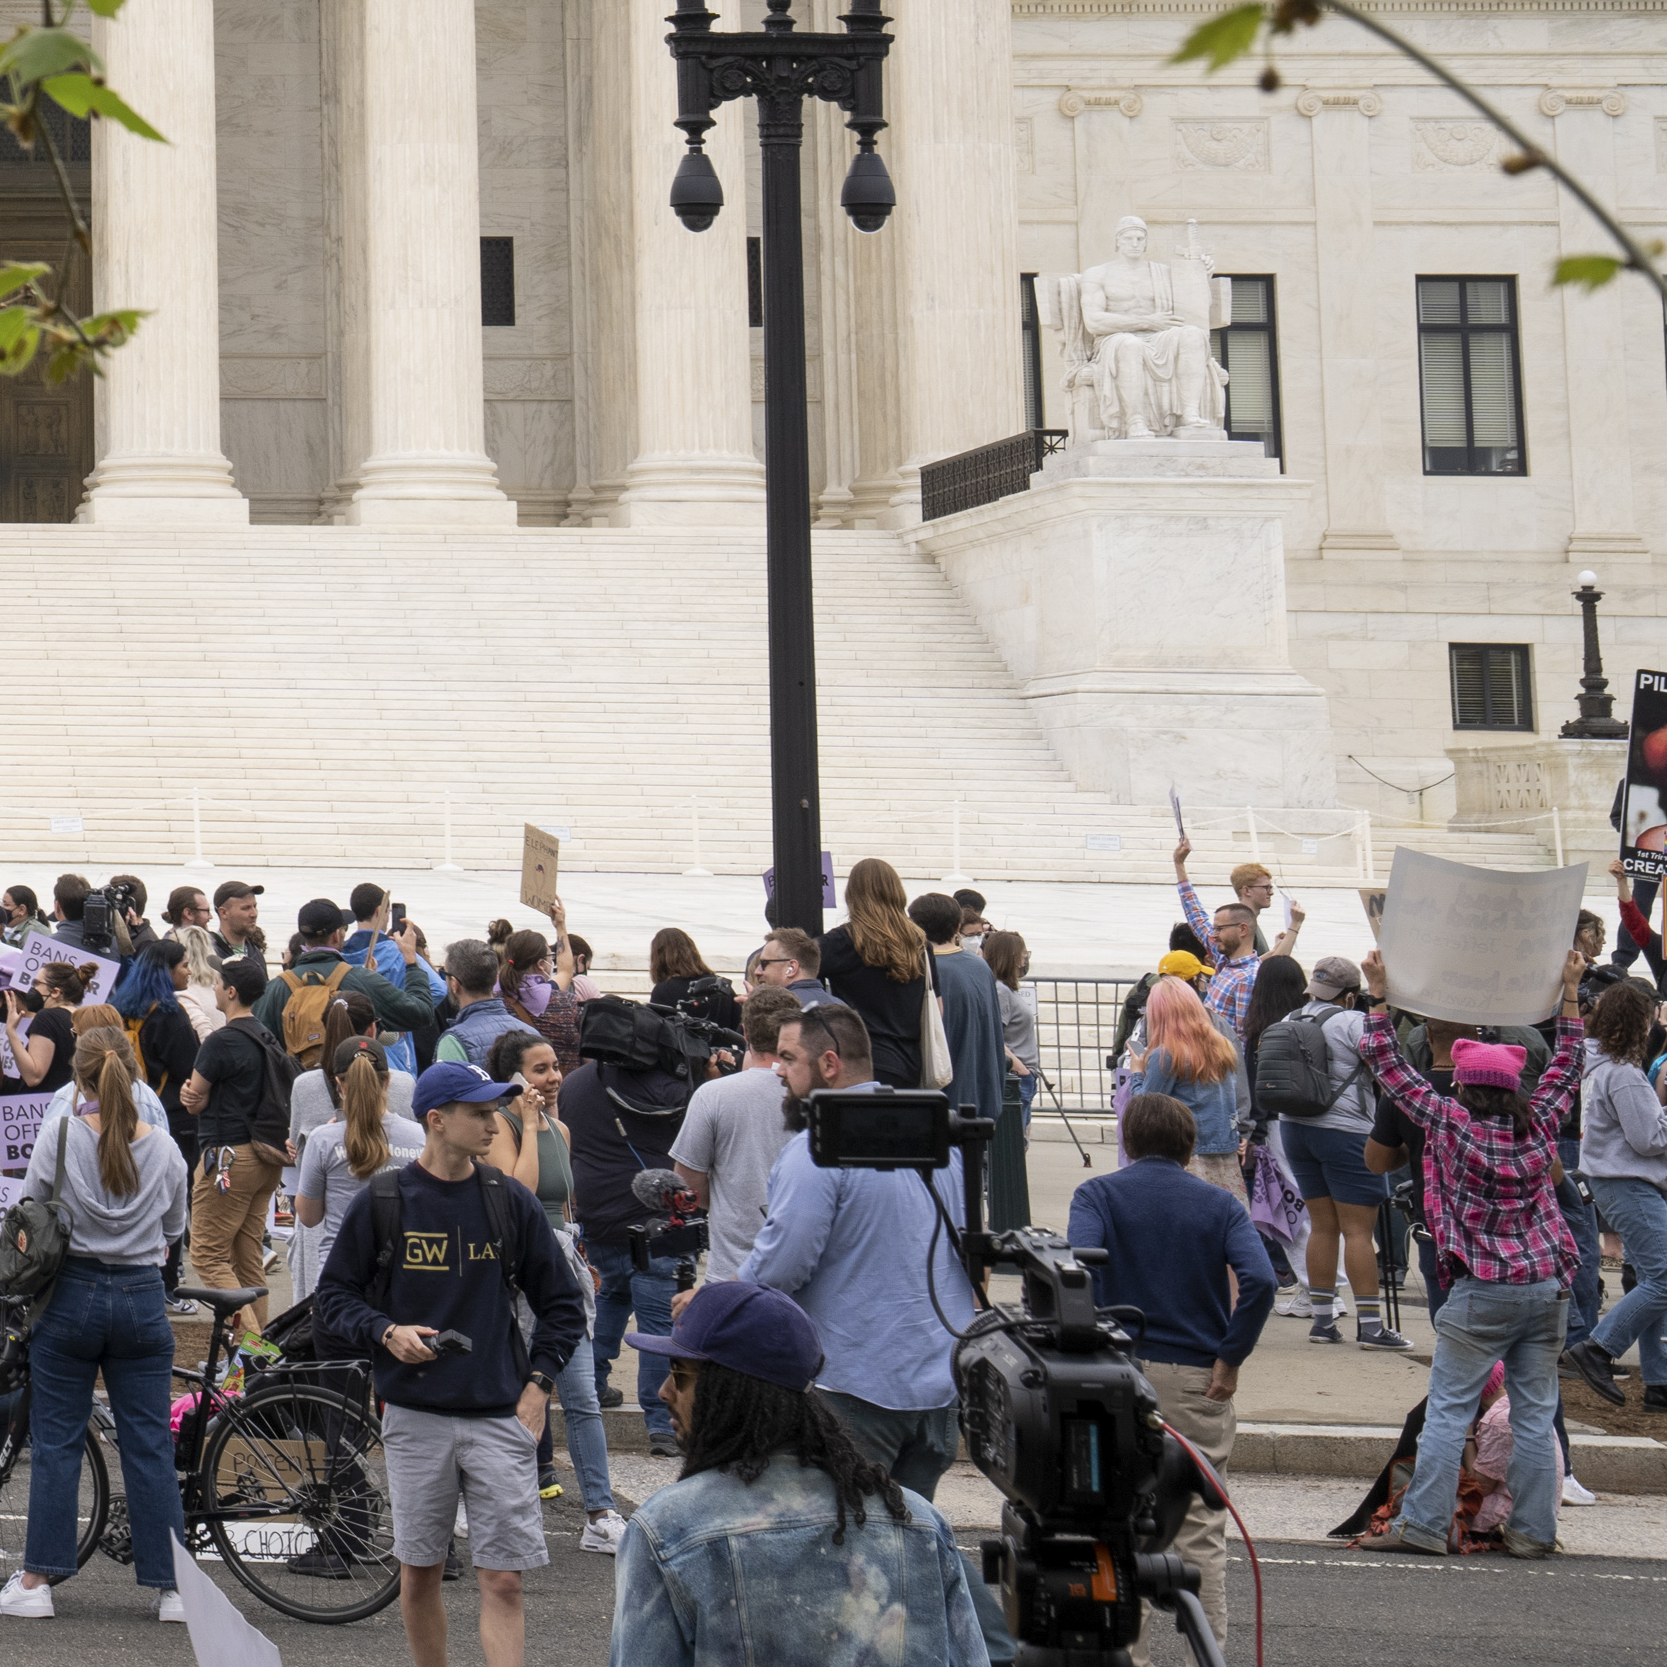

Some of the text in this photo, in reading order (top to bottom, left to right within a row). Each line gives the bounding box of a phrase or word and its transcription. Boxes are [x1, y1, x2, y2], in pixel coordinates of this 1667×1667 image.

[525, 835, 559, 859] ELEPHANT
[1637, 850, 1650, 859] 1st
[1623, 858, 1667, 875] CREA
[30, 940, 78, 967] BANS
[1, 1055, 15, 1070] IES
[2, 1102, 51, 1121] BAN
[406, 1237, 497, 1264] GW LA
